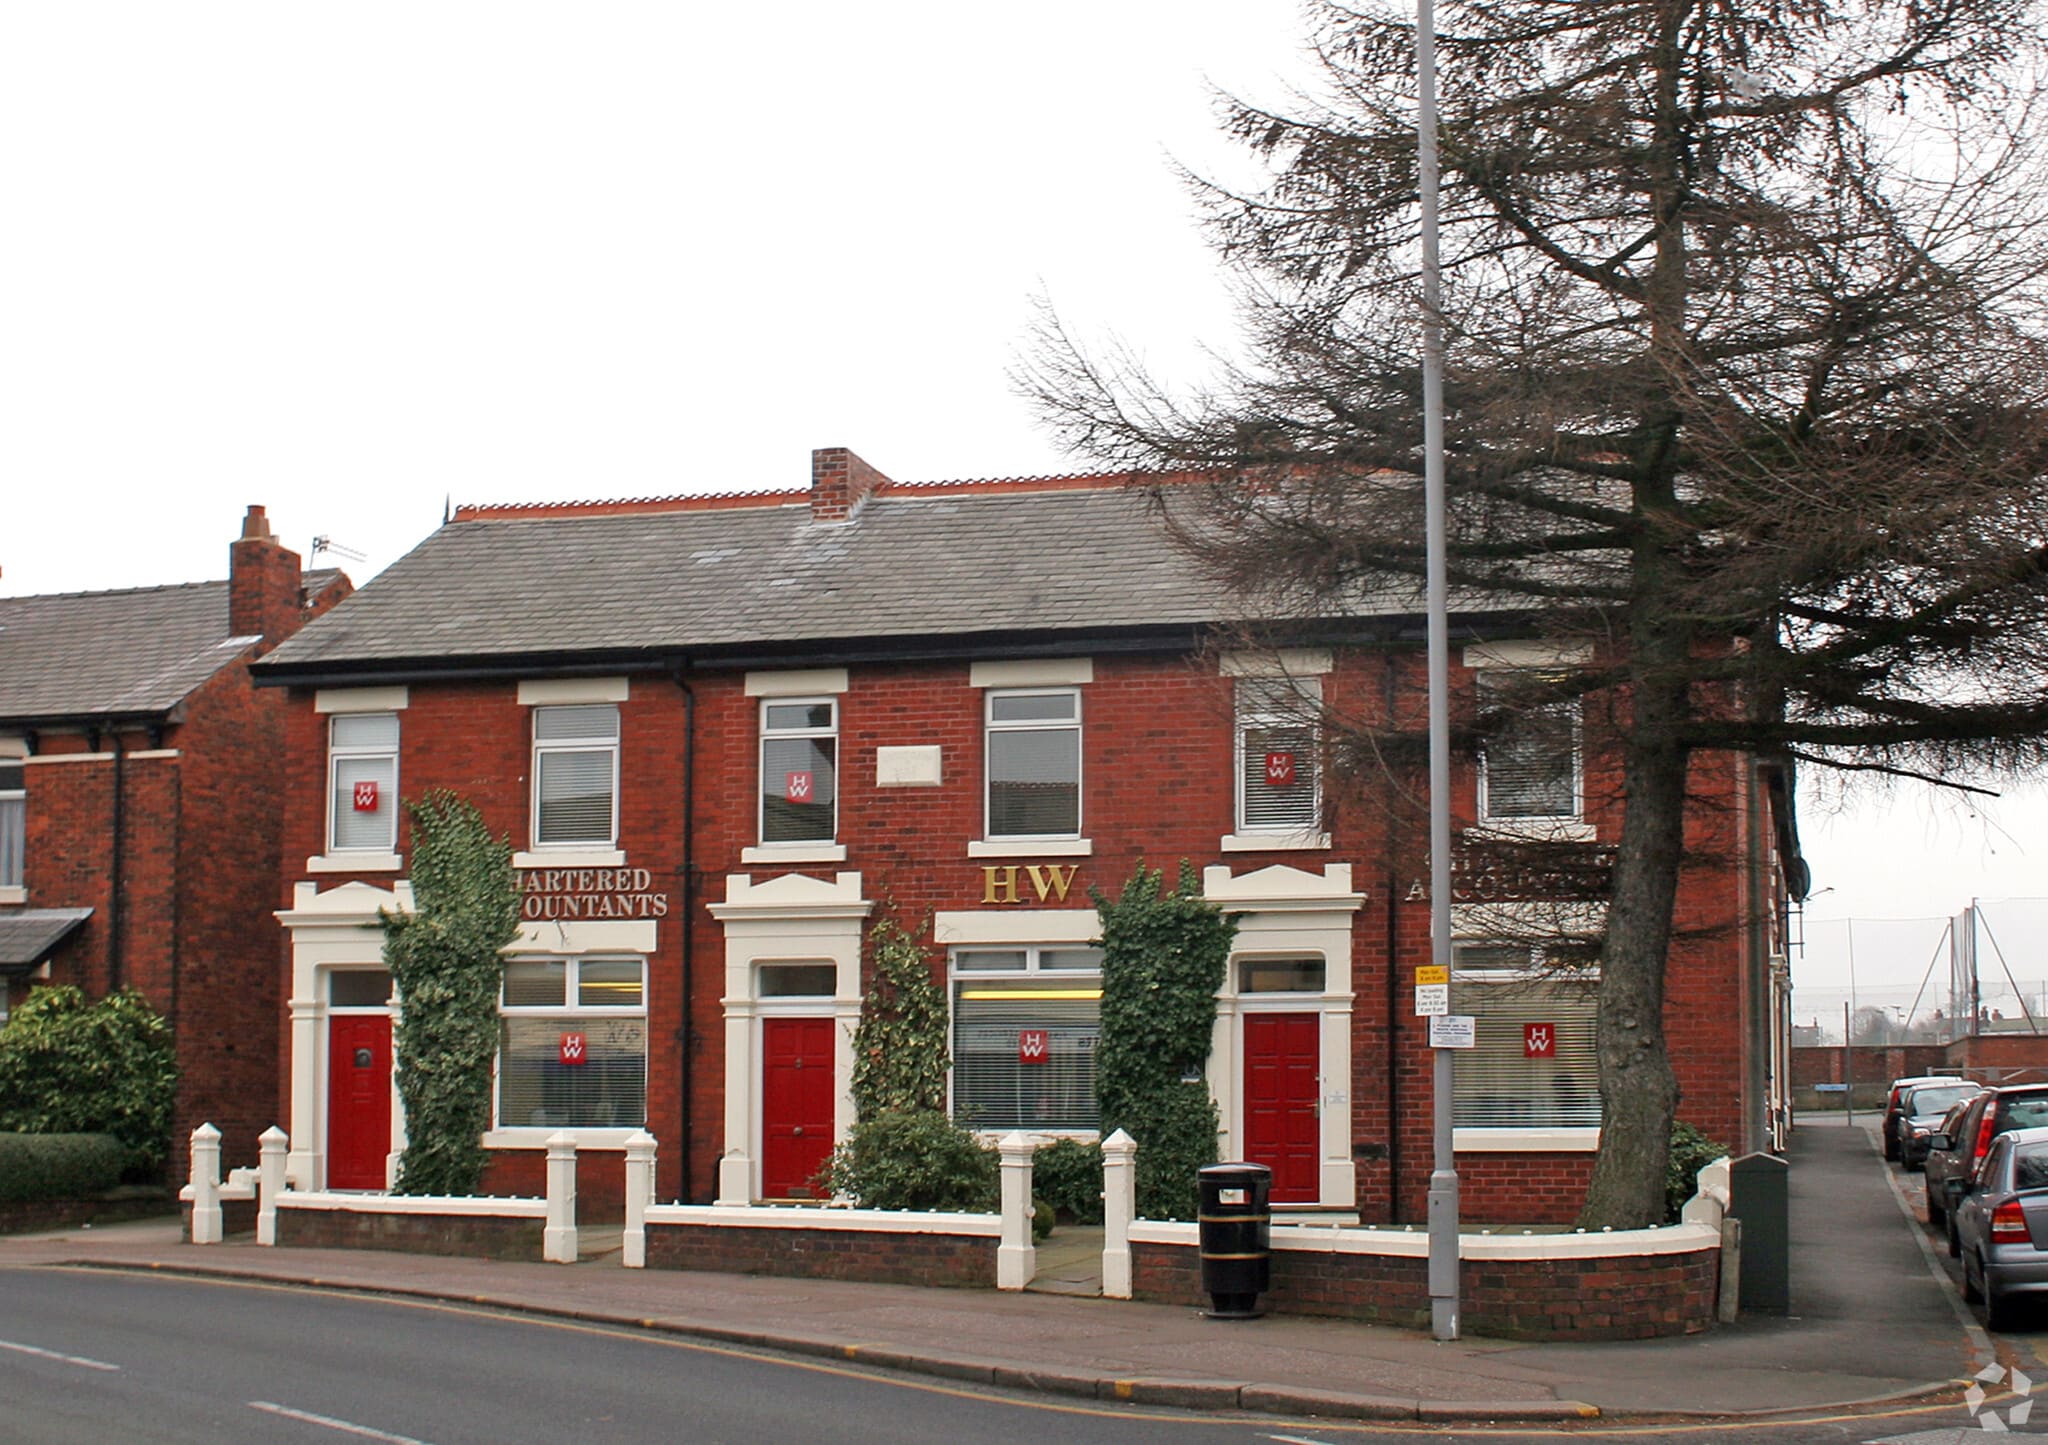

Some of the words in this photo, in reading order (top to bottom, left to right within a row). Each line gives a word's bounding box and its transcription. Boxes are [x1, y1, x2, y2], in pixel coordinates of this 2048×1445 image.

[510, 868, 651, 892] HARTERED
[981, 865, 1079, 903] HW
[524, 893, 668, 918] OUNTANTS
